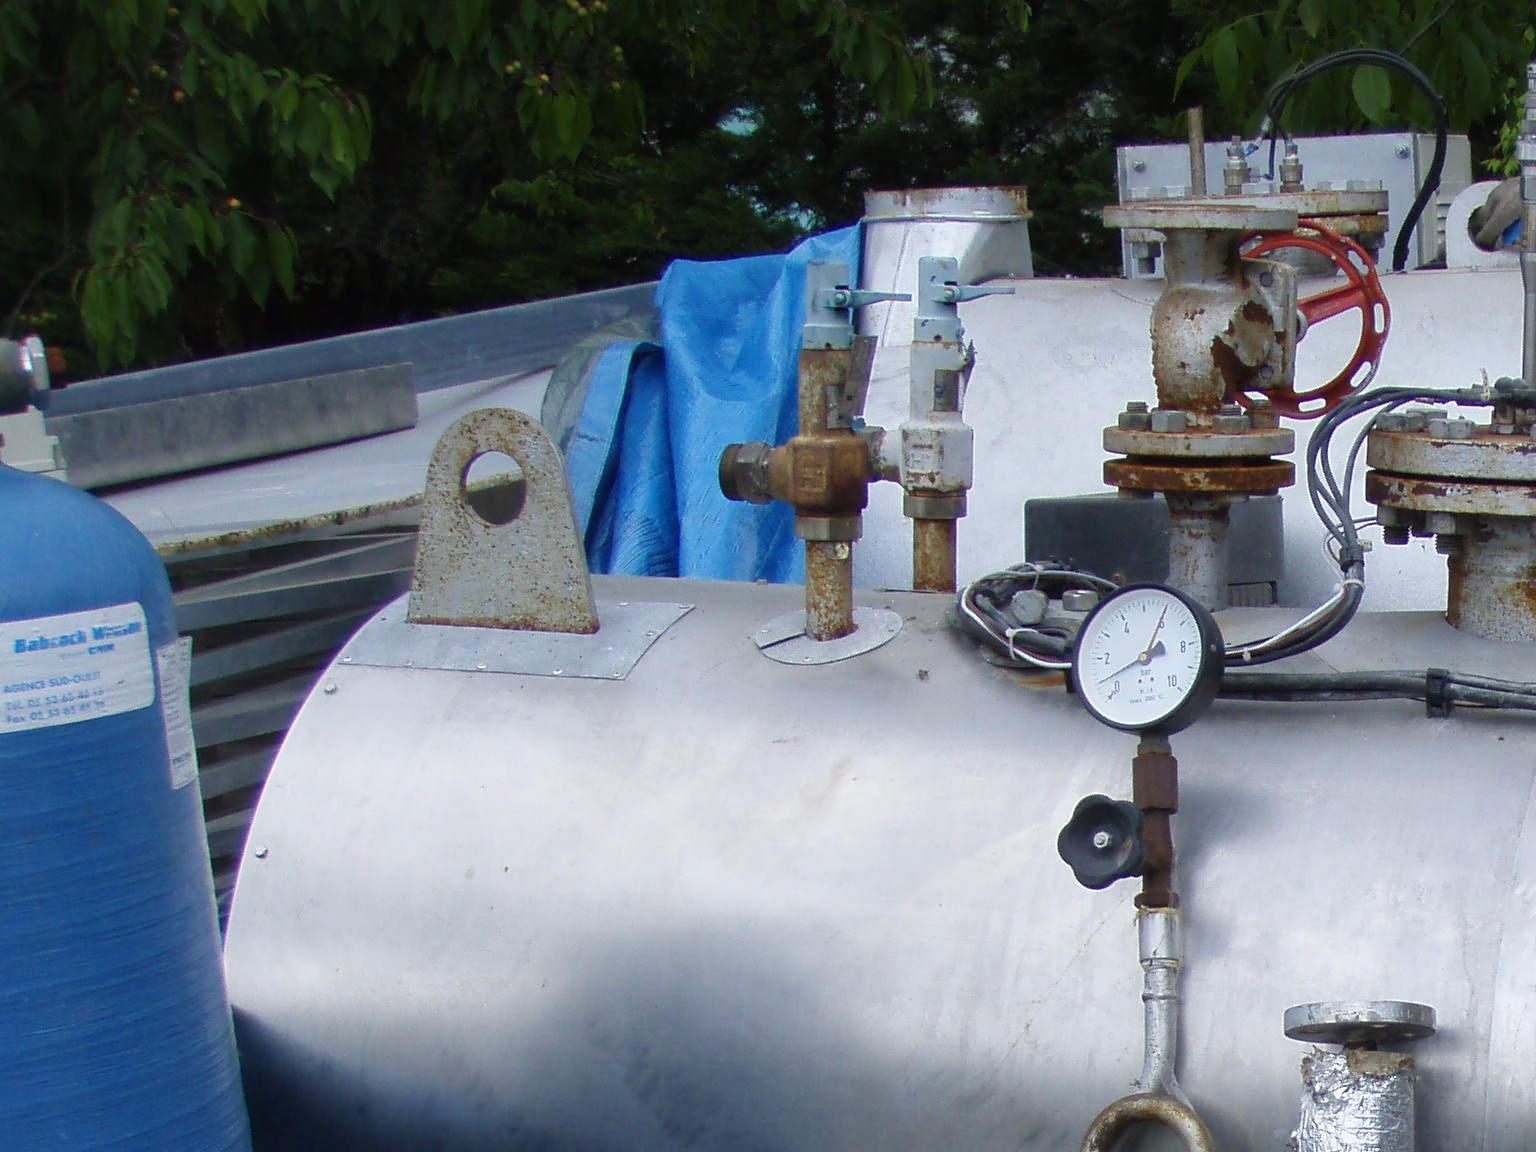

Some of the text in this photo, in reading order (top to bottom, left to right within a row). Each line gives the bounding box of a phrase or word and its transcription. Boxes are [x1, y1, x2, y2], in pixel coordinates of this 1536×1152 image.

[1180, 641, 1186, 653] 8
[1104, 652, 1110, 665] 2
[5, 680, 46, 694] AGENCE
[1167, 675, 1177, 687] 10
[7, 714, 25, 723] Fax
